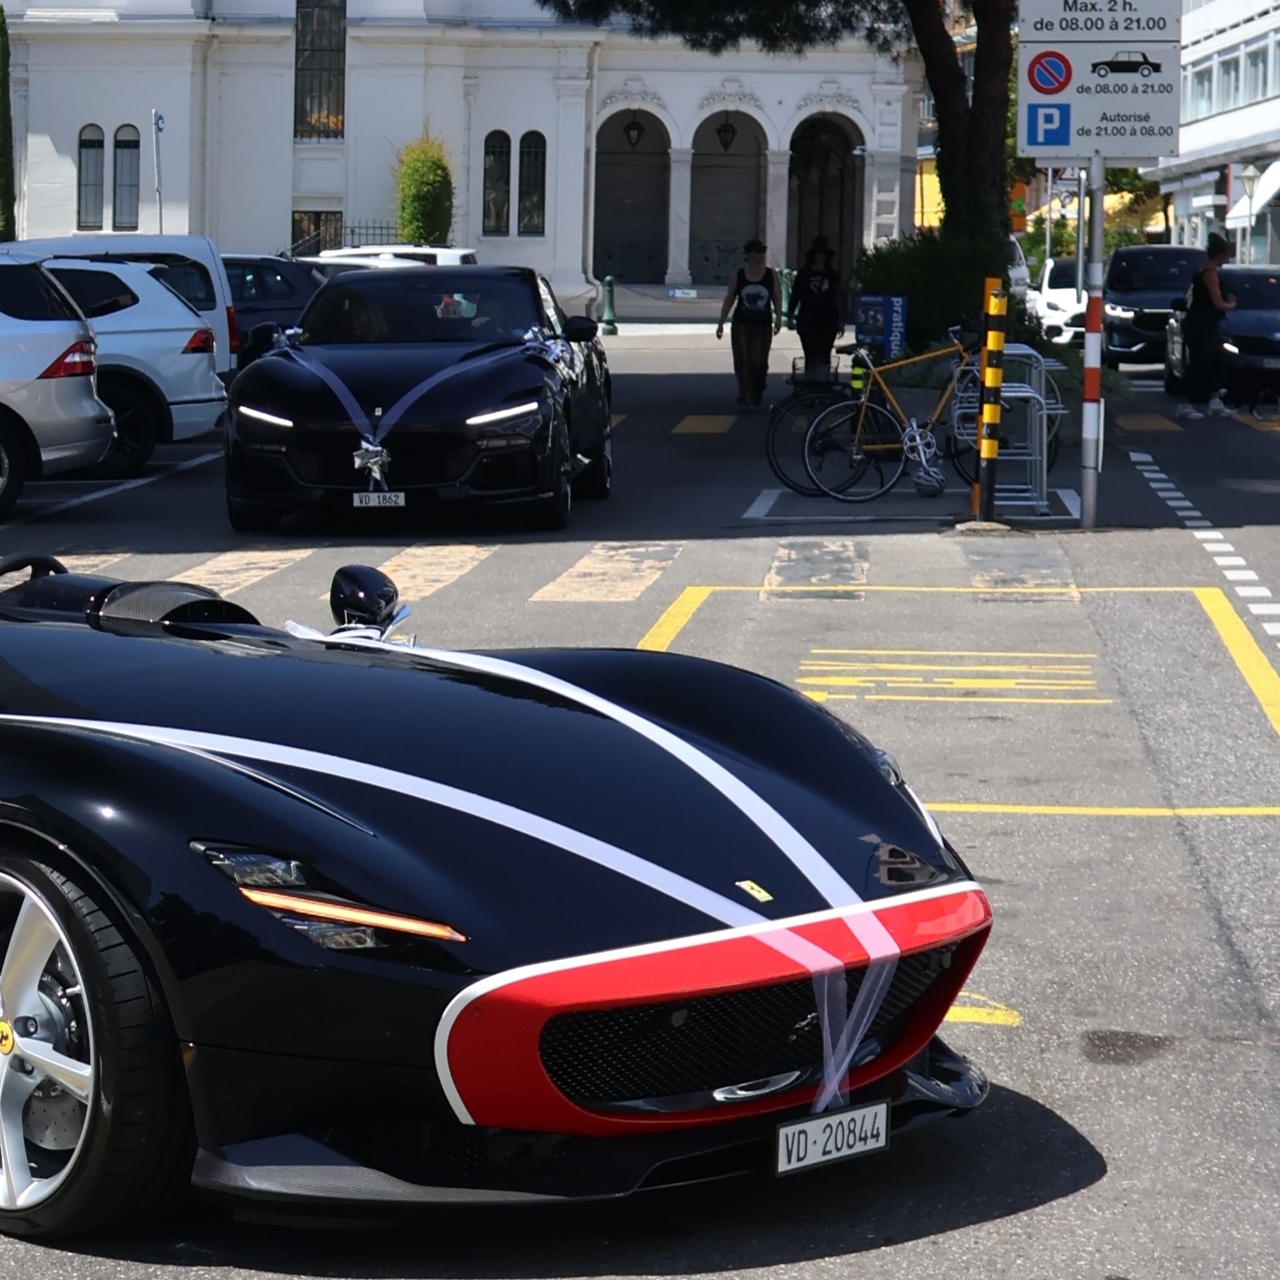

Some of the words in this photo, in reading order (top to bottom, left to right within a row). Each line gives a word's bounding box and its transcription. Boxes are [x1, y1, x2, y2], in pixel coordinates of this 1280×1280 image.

[1063, 0, 1103, 12] Max.
[1107, 0, 1118, 12] 2
[1122, 0, 1138, 12] h.
[1033, 18, 1054, 32] de
[1059, 17, 1105, 31] 08.00
[1109, 17, 1119, 31] à
[1123, 17, 1167, 31] 21.00
[1076, 83, 1093, 94] de
[1094, 83, 1128, 94] 08.00
[1131, 83, 1139, 94] à
[1141, 83, 1173, 94] 21.00
[1099, 111, 1151, 123] Autorisé
[1037, 107, 1061, 143] P
[1076, 125, 1093, 137] de
[1095, 126, 1127, 137] 21.00
[1129, 125, 1137, 137] à
[1139, 125, 1174, 136] 08.00
